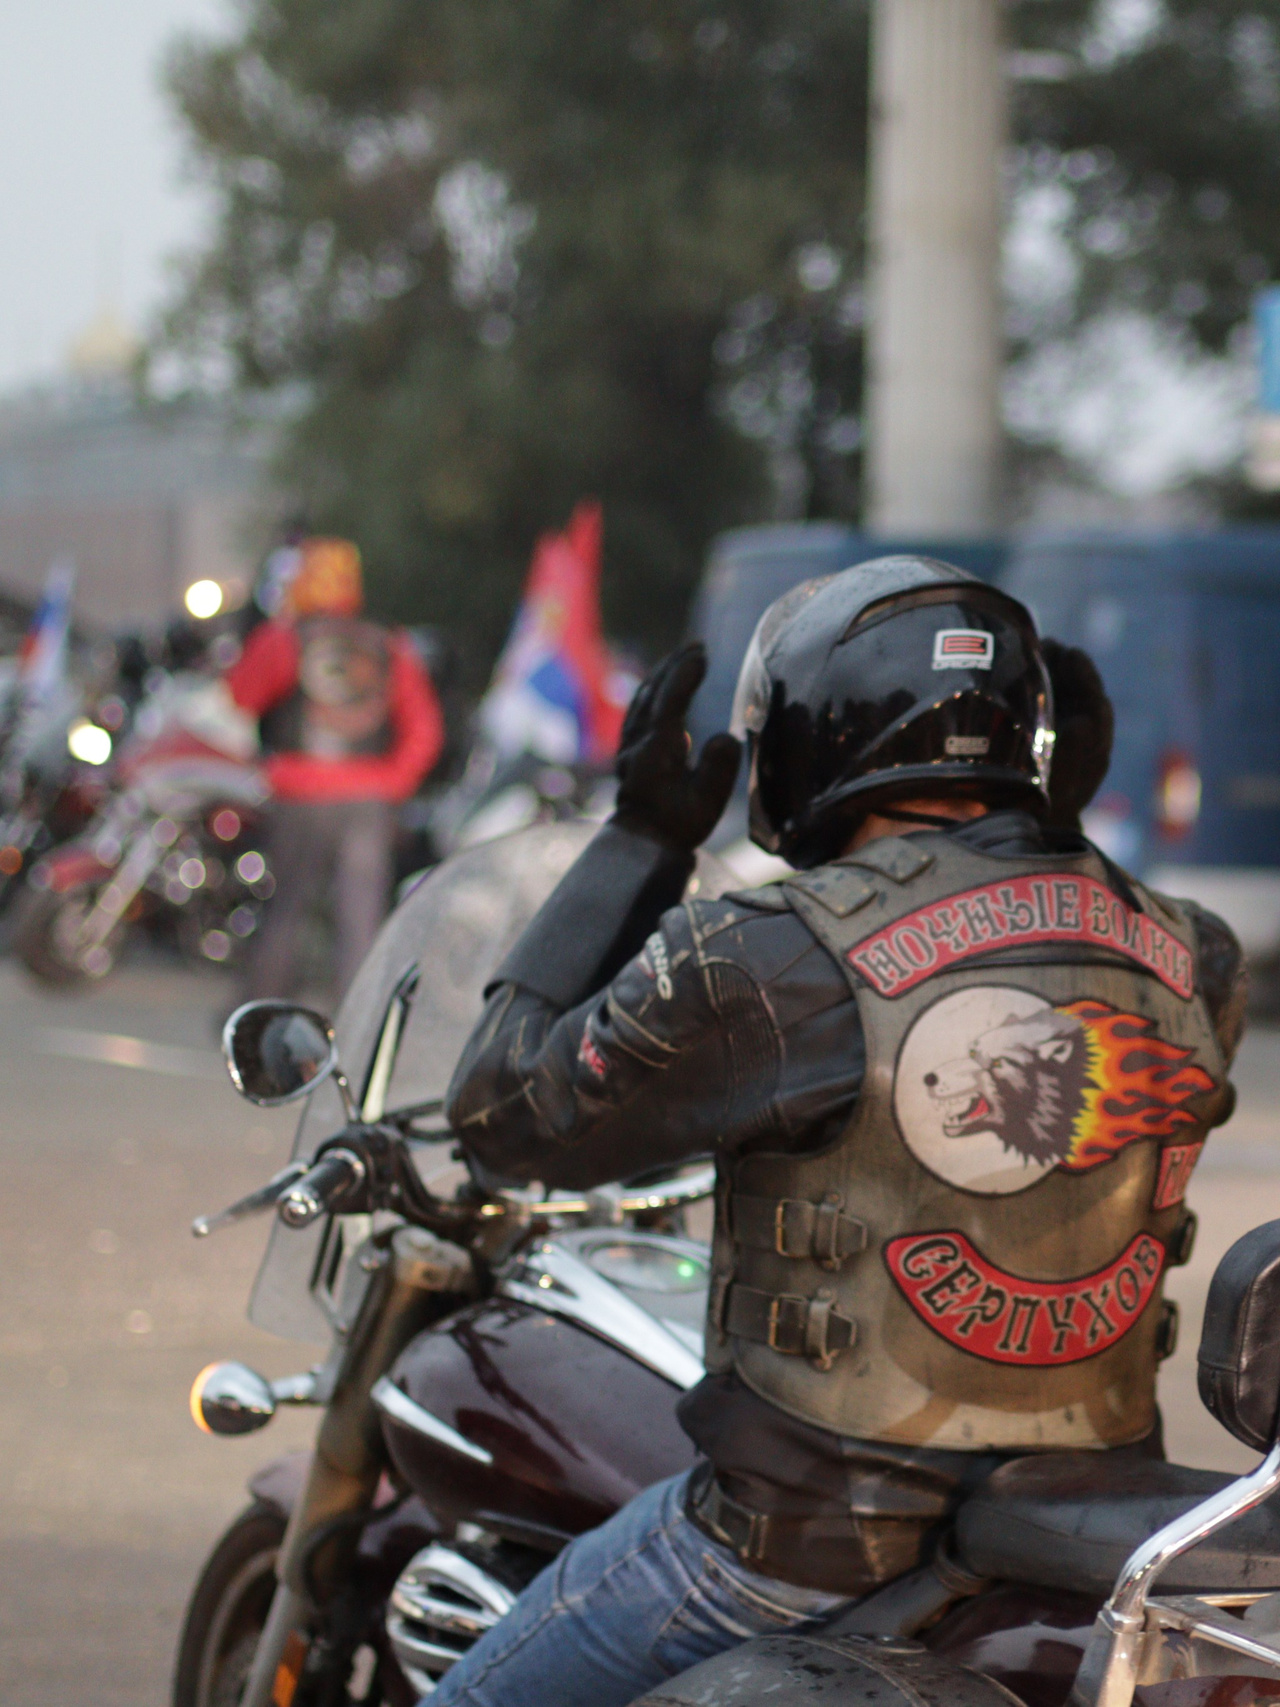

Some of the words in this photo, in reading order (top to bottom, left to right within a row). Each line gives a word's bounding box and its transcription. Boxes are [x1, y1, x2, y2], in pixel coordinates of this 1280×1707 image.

[856, 881, 1081, 992] НОЧНЫЕ
[1088, 886, 1190, 991] ВОЛКИ
[901, 1237, 1161, 1354] СЕРПУХОВ
